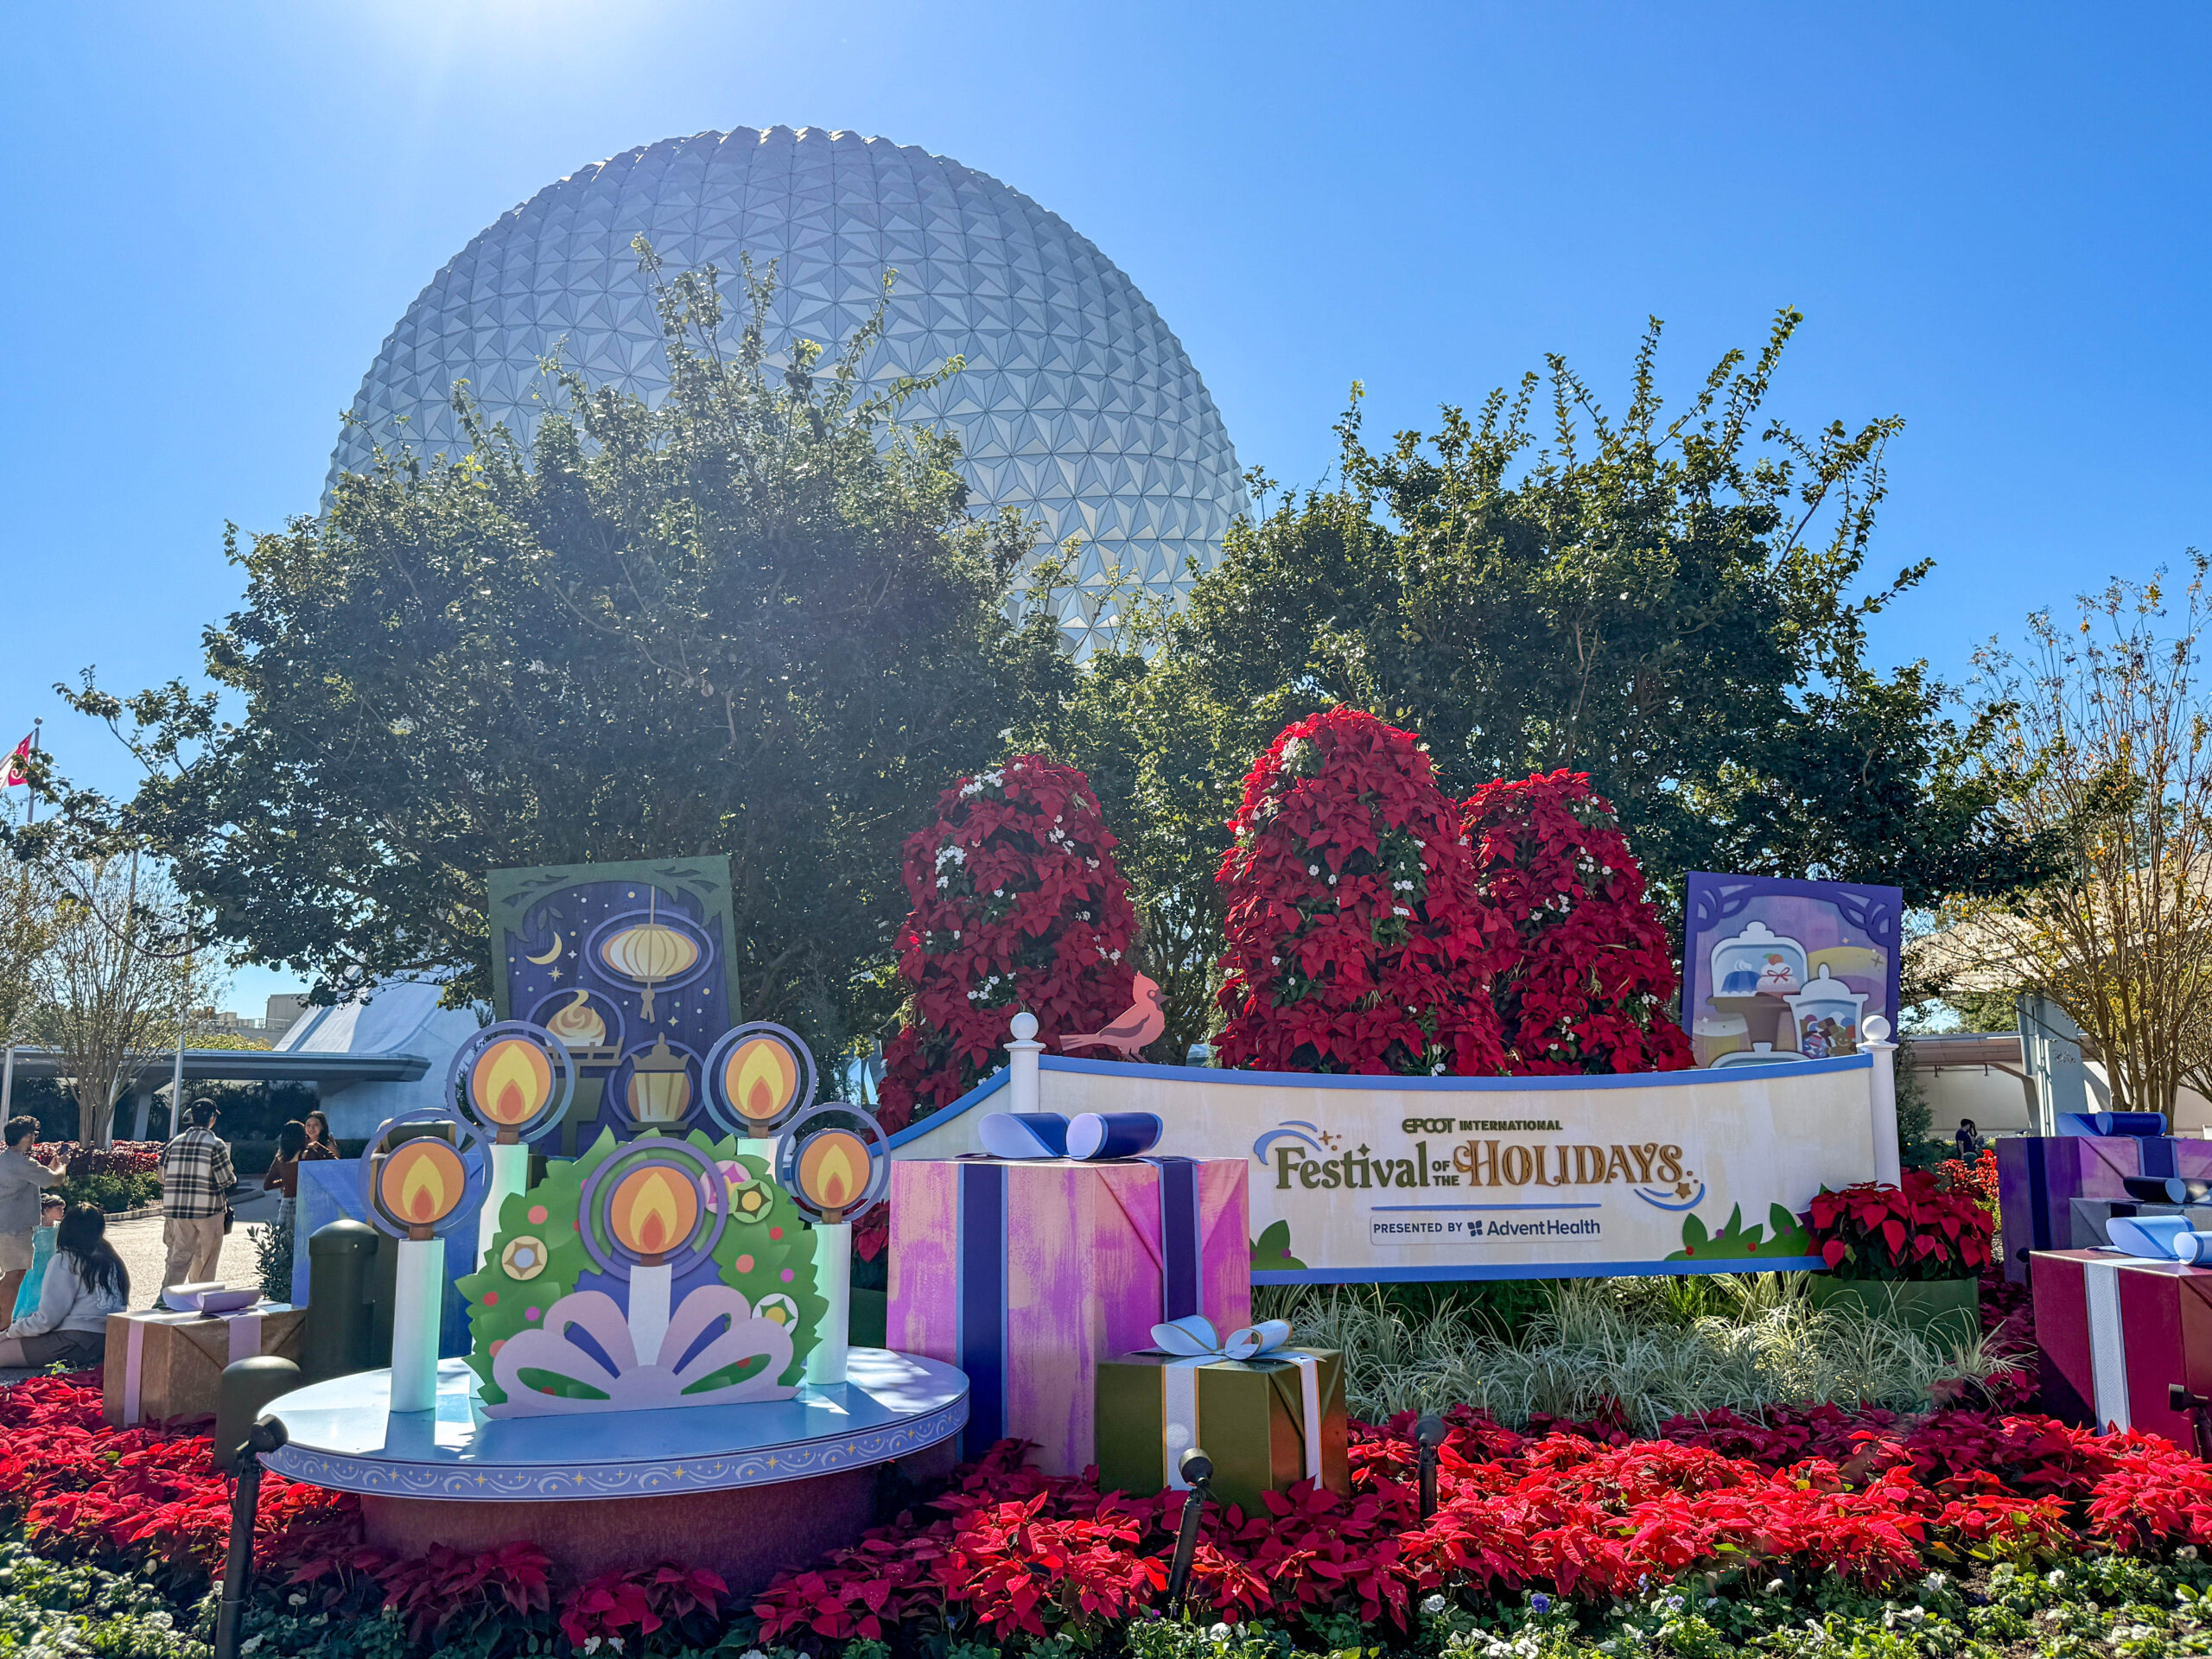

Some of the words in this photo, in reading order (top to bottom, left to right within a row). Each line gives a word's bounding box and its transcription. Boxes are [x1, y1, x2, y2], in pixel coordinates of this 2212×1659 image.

[1401, 1118, 1455, 1134] EPCOT
[1459, 1119, 1563, 1131] INTERNATIONAL
[1275, 1141, 1430, 1189] Festival
[1432, 1160, 1451, 1172] OF
[1454, 1140, 1682, 1187] HOLIDAYS
[1433, 1175, 1460, 1186] THE
[1373, 1223, 1445, 1234] PRESENTED
[1448, 1222, 1463, 1233] BY
[1487, 1219, 1600, 1236] AdventHealth
